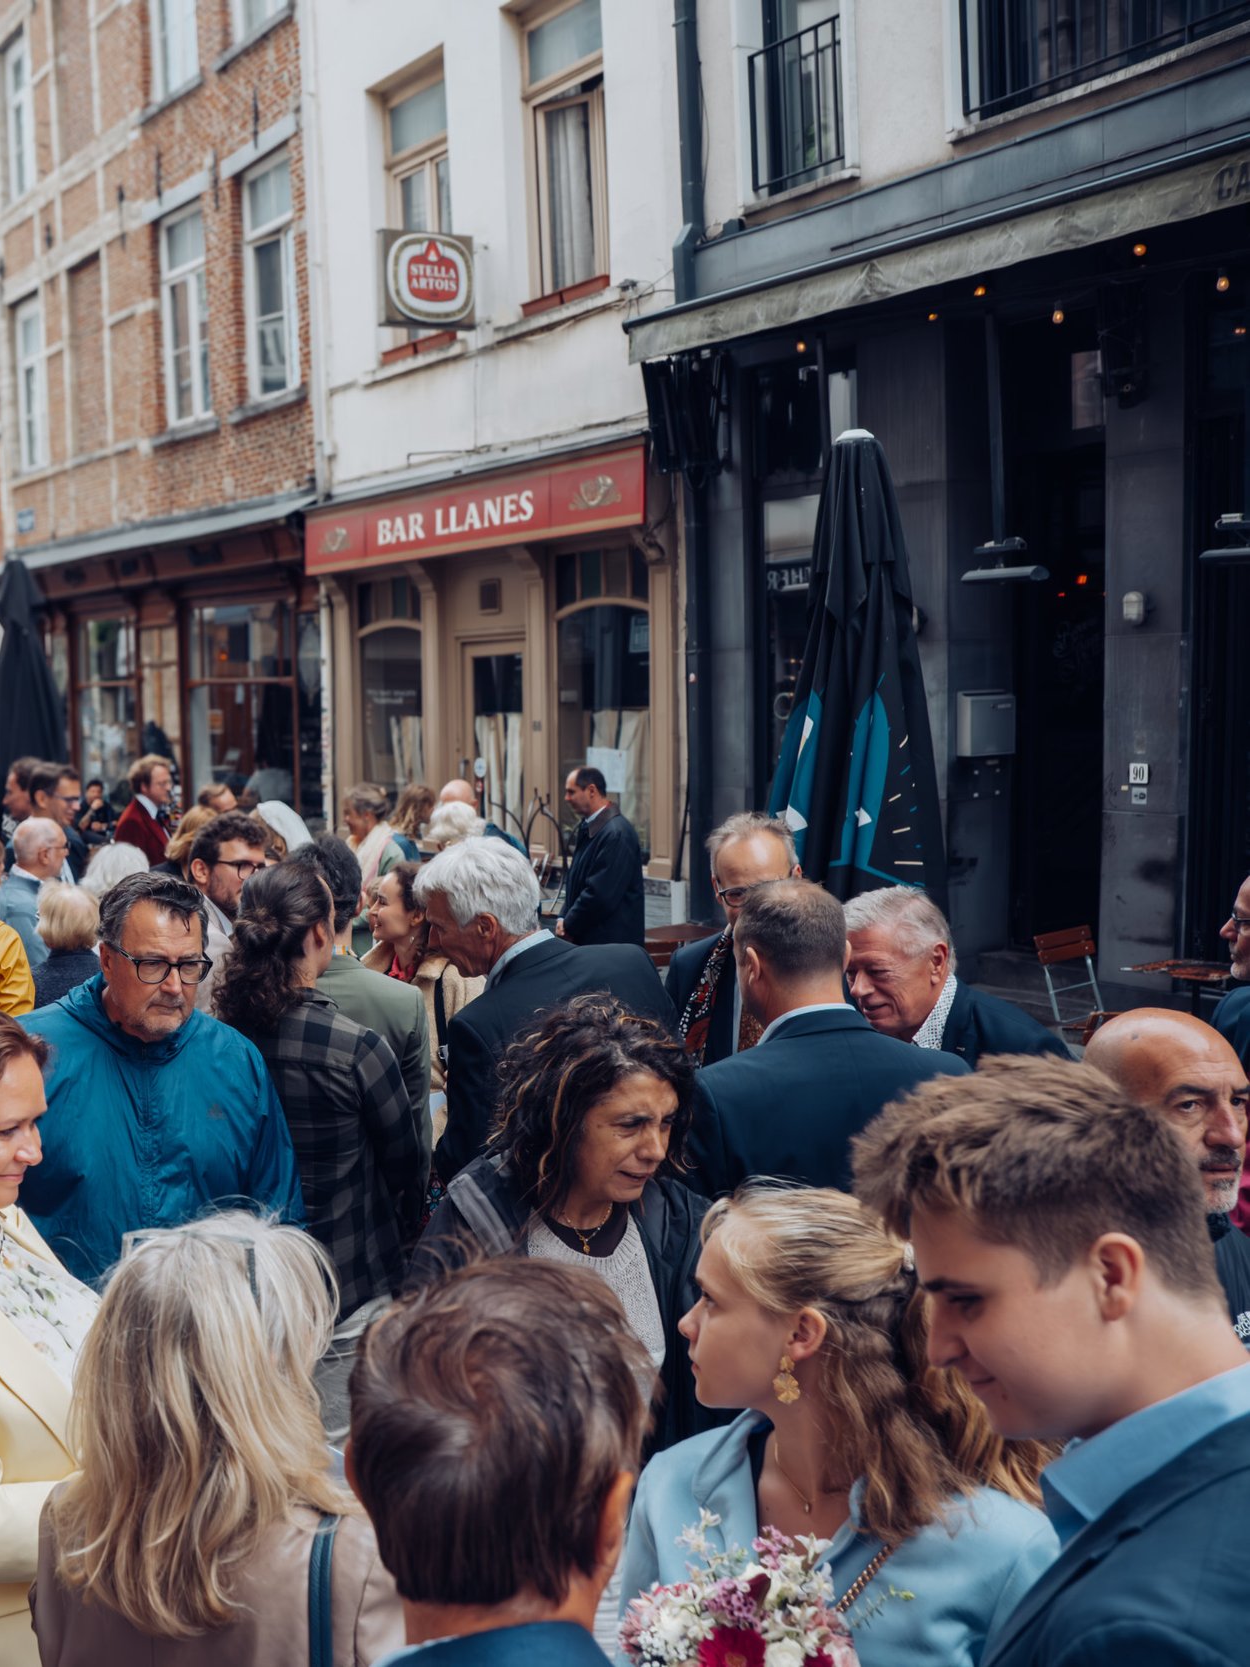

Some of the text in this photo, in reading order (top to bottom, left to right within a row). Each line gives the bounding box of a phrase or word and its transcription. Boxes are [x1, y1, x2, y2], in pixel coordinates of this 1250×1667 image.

[410, 263, 456, 279] STELLA
[410, 278, 457, 292] ARTOIS
[377, 490, 535, 546] BAR LLANES
[1132, 766, 1145, 781] 90
